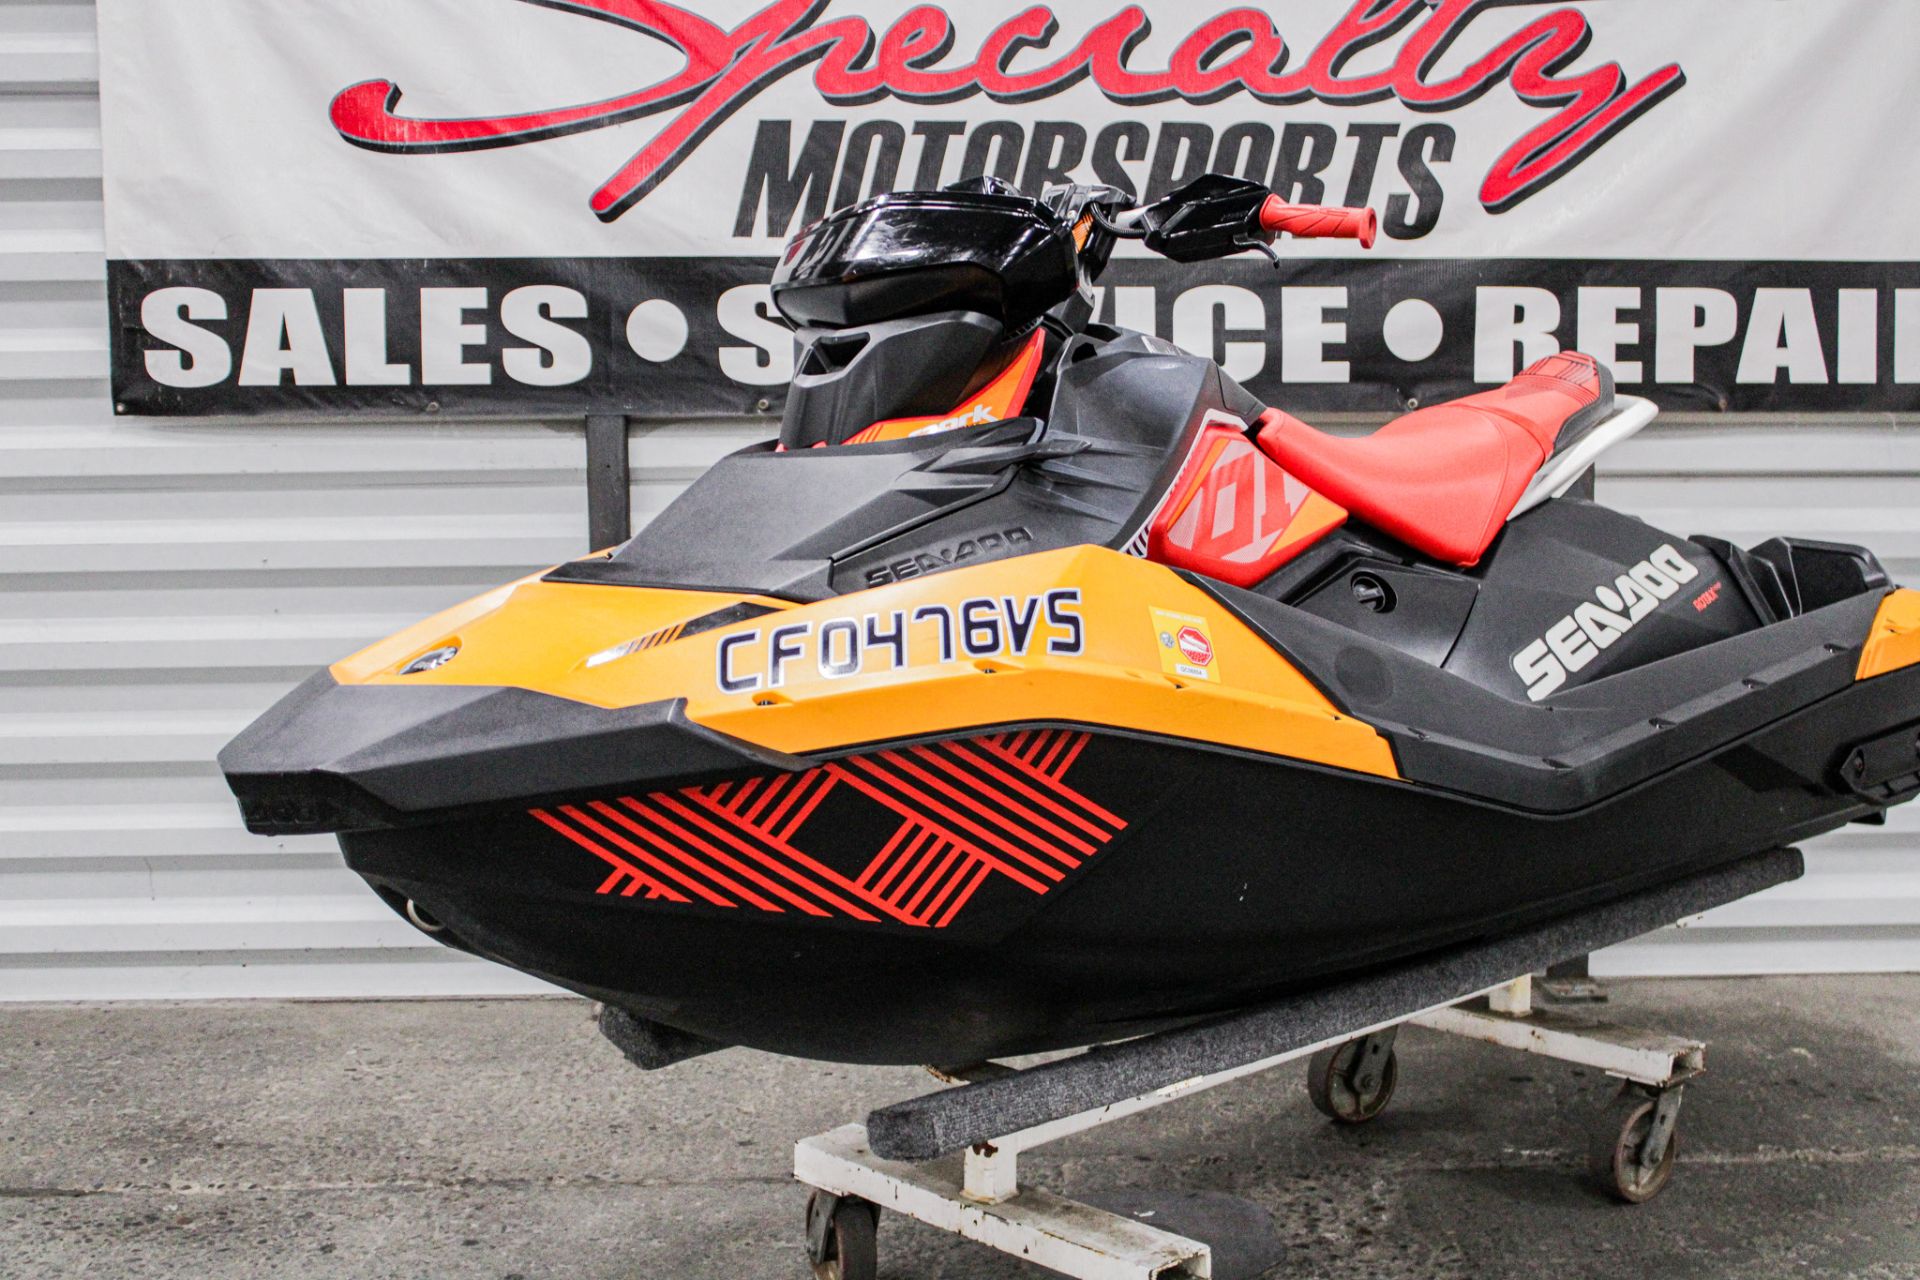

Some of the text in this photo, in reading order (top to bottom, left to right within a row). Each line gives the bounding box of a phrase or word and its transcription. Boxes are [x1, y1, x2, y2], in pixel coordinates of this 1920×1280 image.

[733, 119, 1456, 240] MOTORSPORTS
[140, 285, 592, 388] SALES
[1474, 286, 1920, 384] REPAI
[716, 587, 1084, 694] CF0476VS
